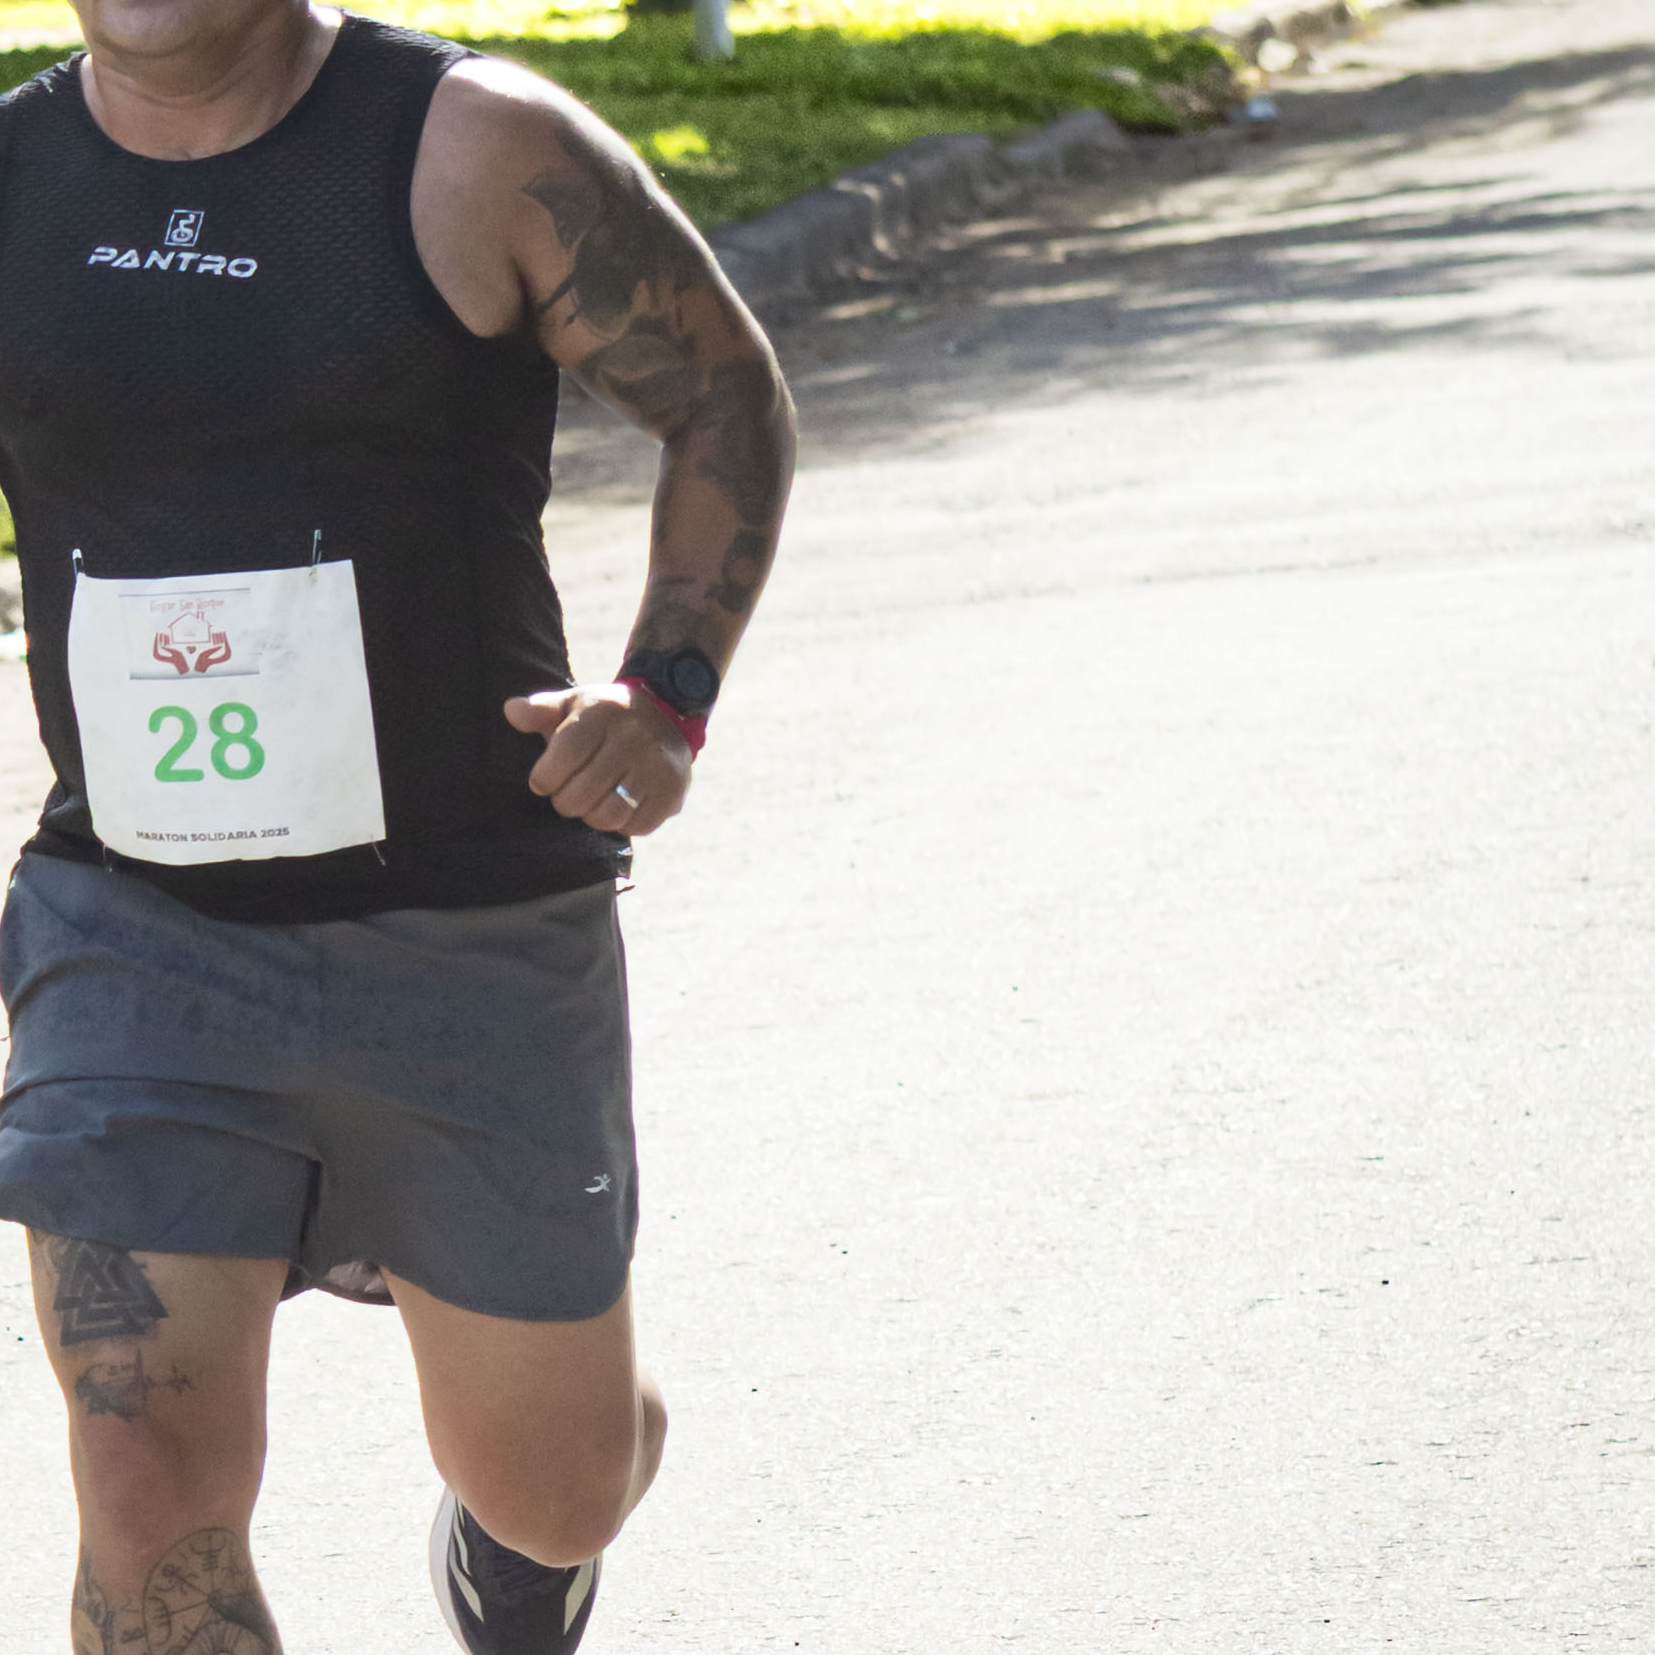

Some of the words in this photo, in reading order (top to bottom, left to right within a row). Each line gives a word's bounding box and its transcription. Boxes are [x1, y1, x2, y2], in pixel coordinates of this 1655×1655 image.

[87, 246, 258, 278] PANTRO
[148, 702, 265, 783] 28
[136, 830, 188, 842] MARATON
[191, 830, 257, 842] SOLIDARIA
[260, 827, 290, 838] 2025
